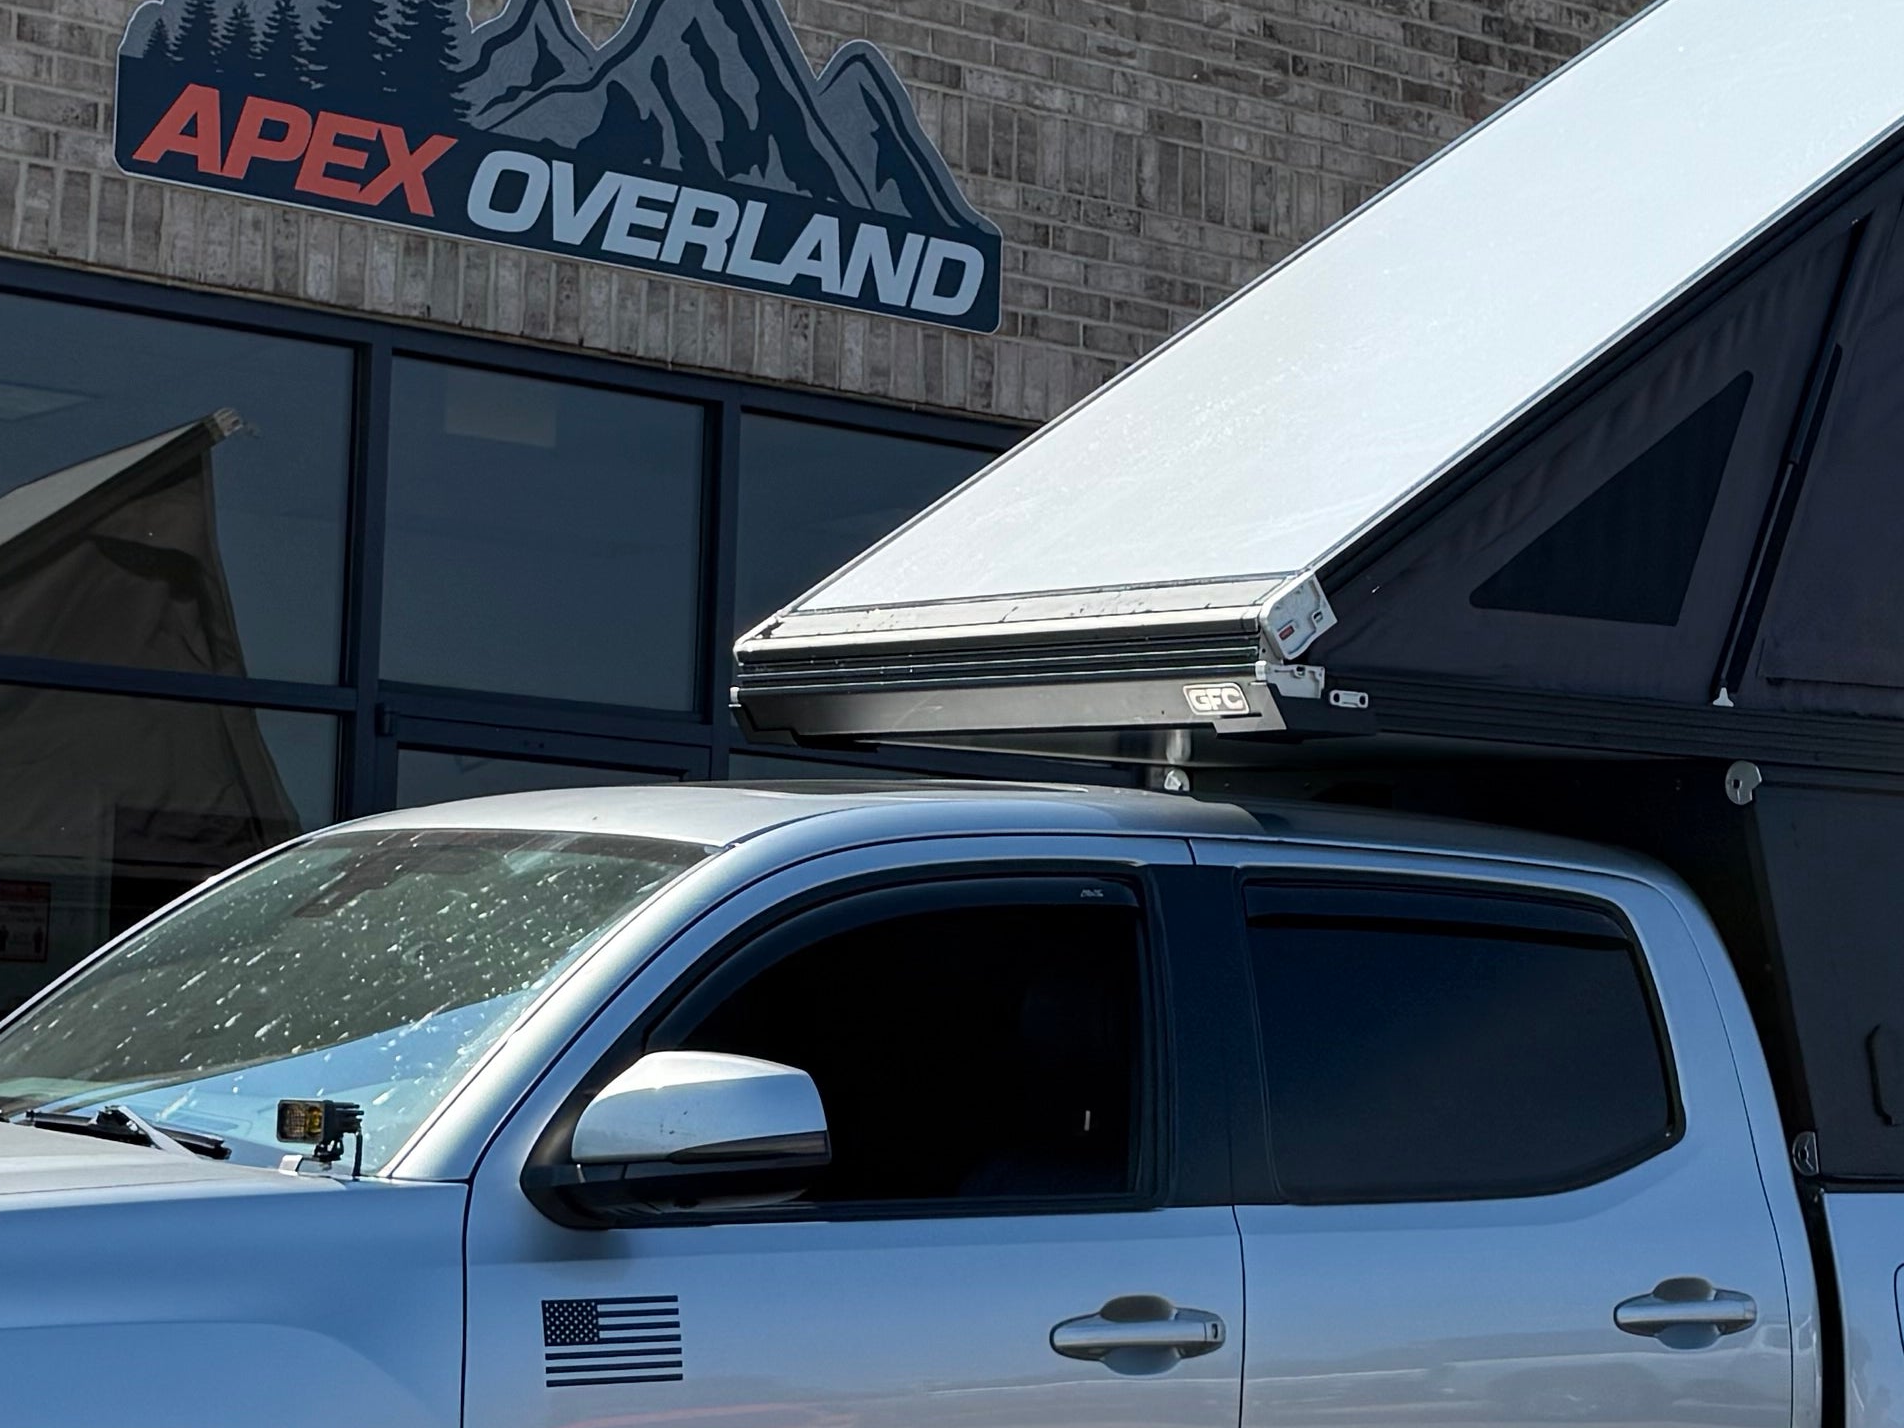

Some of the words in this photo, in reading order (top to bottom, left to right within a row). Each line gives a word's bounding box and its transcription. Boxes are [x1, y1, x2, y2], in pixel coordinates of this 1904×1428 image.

[132, 83, 458, 217] APEX
[467, 151, 984, 316] OVERLAND
[1188, 687, 1244, 711] GFC
